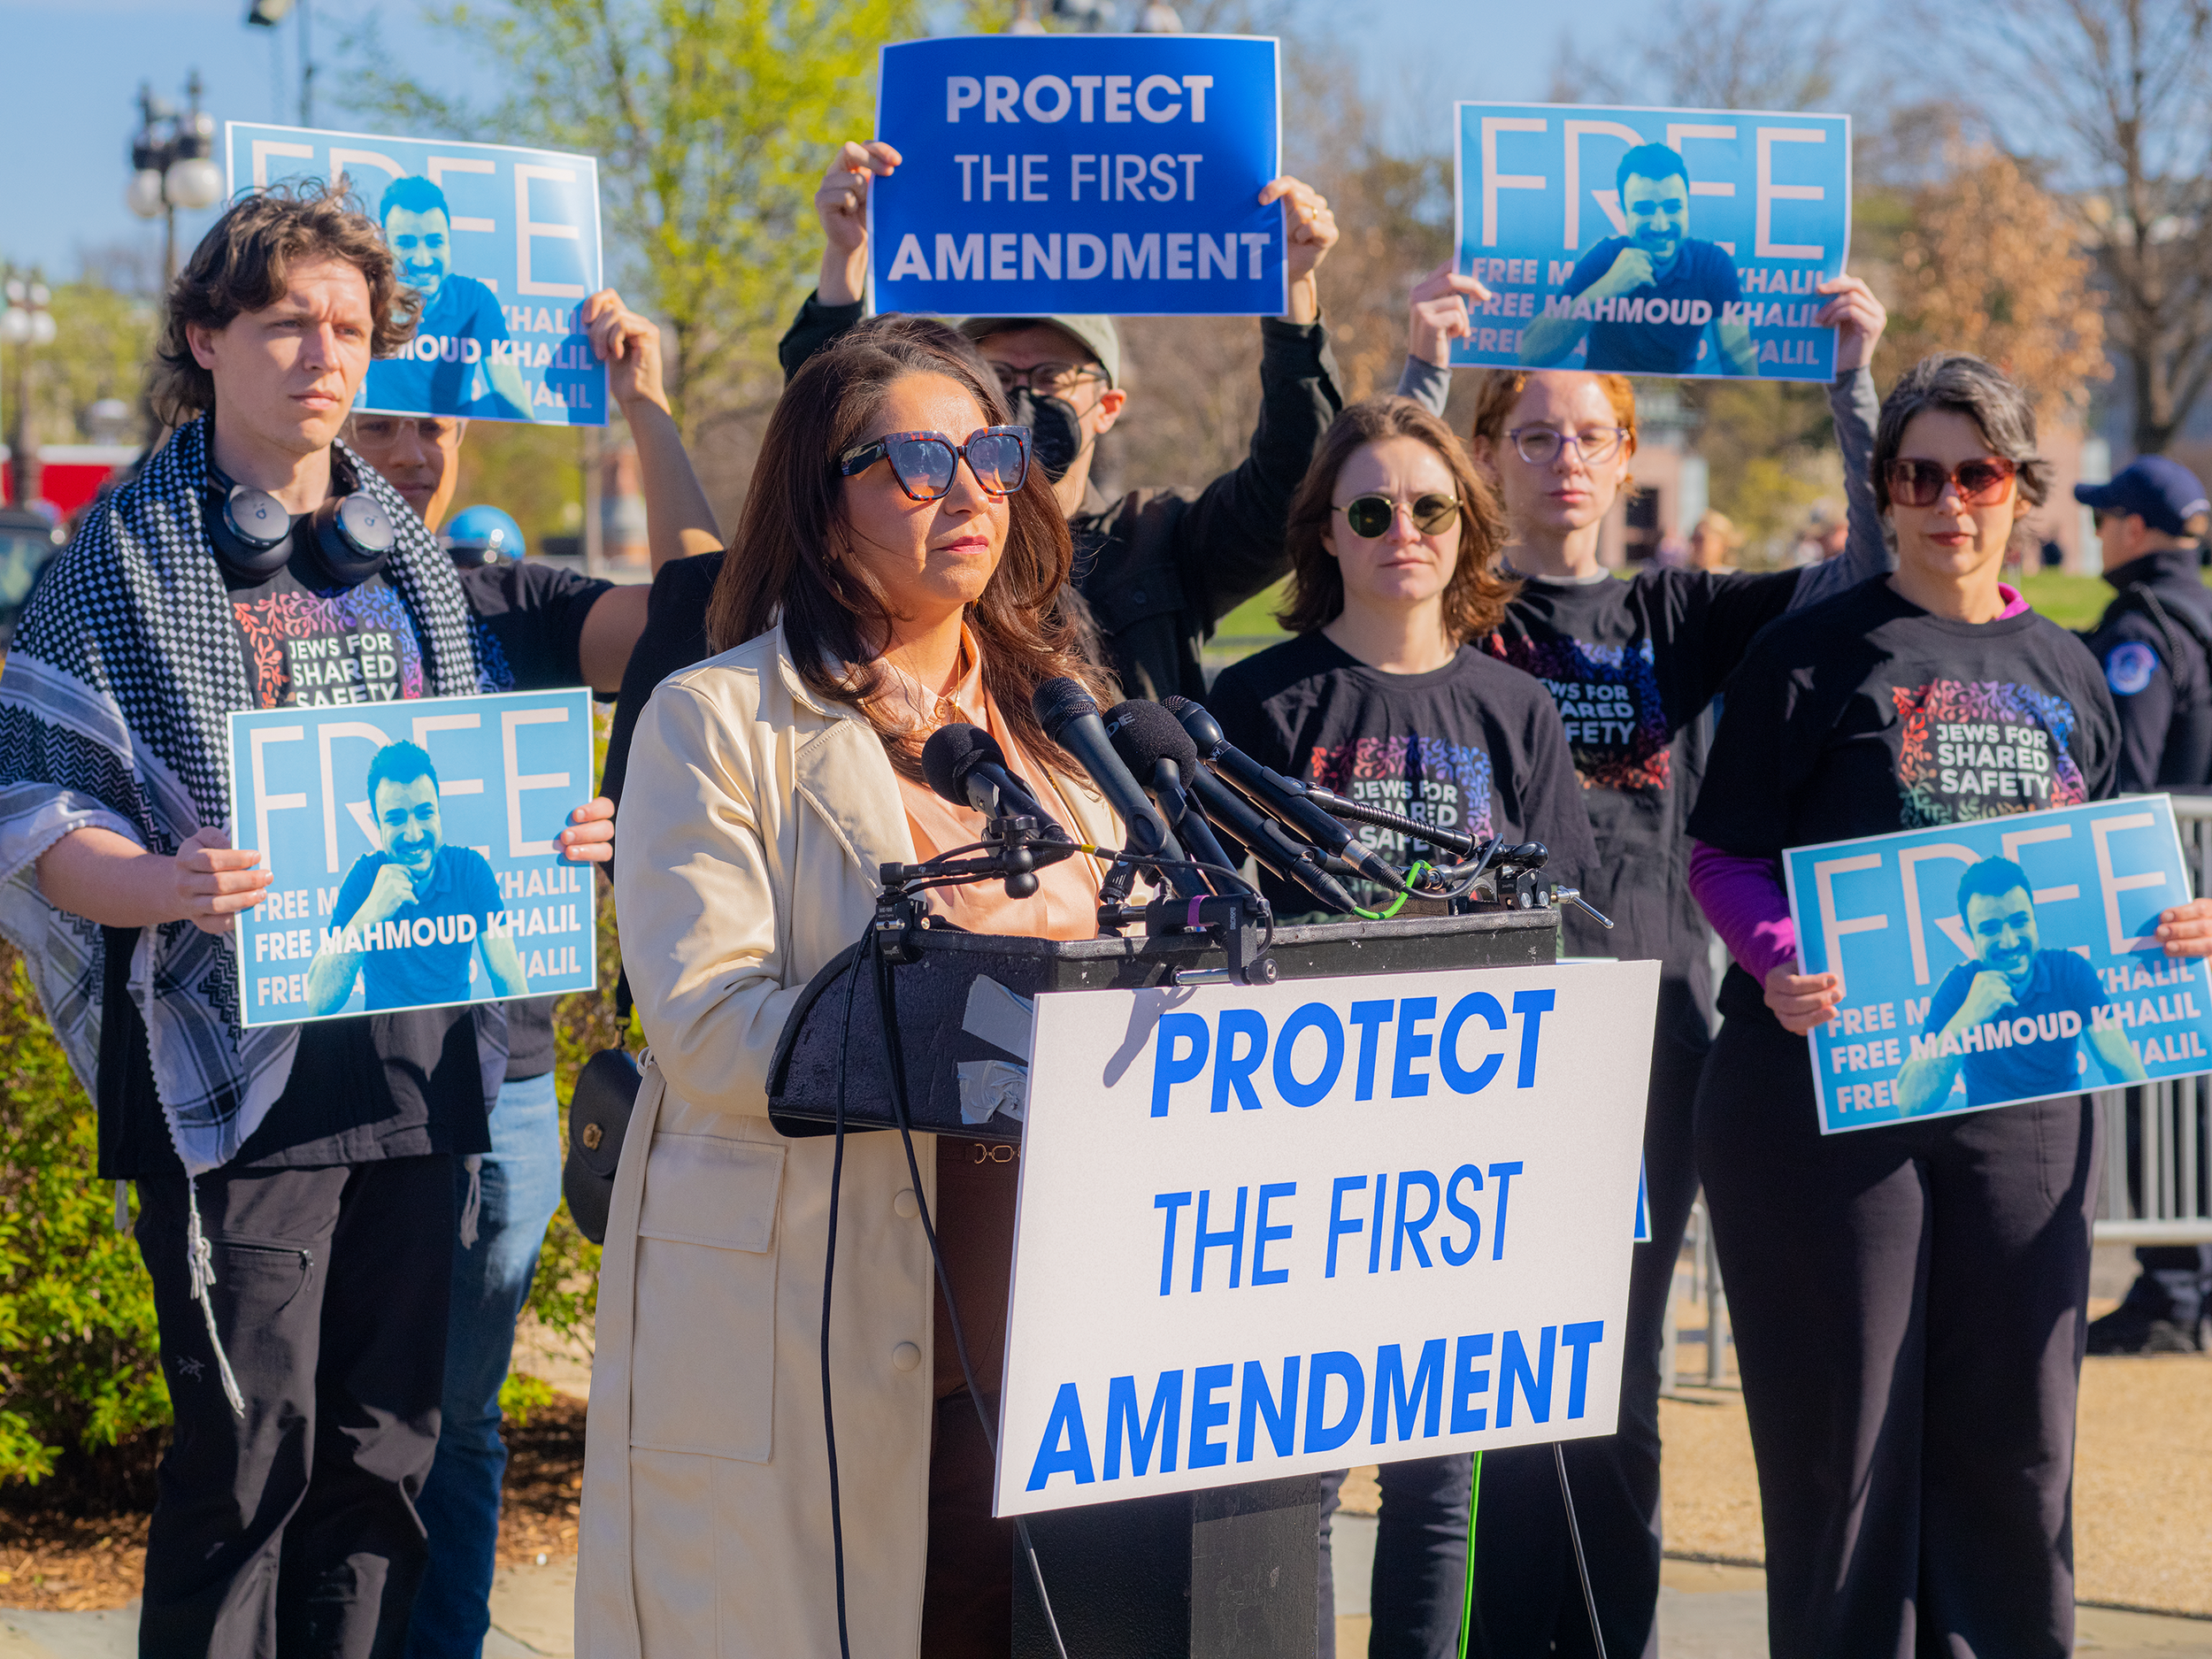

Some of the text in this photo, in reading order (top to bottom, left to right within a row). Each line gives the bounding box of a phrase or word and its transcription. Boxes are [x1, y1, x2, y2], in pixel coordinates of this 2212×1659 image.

[947, 73, 1214, 124] PROTECT
[954, 153, 1203, 202] THE FIRST
[1481, 116, 1827, 260] FREE
[887, 233, 1271, 281] AMENDMENT
[1471, 257, 1538, 284] FREE
[1467, 291, 1823, 328] FREE MAHMOUD KHALIL
[397, 334, 594, 371] MOUD KHALIL
[1751, 338, 1820, 365] ALIL
[525, 380, 593, 409] ALIL
[288, 632, 395, 660] JEWS FOR
[292, 654, 398, 687] SHARED
[1540, 678, 1630, 701] WS FOR
[1560, 700, 1635, 718] ARED
[1564, 720, 1636, 744] FETY
[1936, 724, 2048, 750] JEWS FOR
[1938, 742, 2050, 772] SHARED
[250, 706, 571, 873] FREE
[1353, 780, 1459, 804] JEWS FOR
[1940, 768, 2051, 799] SAFETY
[1360, 800, 1459, 827] ARED
[1358, 826, 1448, 855] SAF
[254, 889, 310, 922] FREE
[1814, 812, 2168, 998] FREE
[255, 903, 581, 963] FREE MAHMOUD KHALIL
[518, 946, 581, 979] ALIL
[1826, 1002, 1896, 1038] FREE
[1831, 1038, 1901, 1074] FREE
[1909, 1010, 2083, 1062] MAHMOUD
[2090, 991, 2202, 1033] KHALIL
[1150, 988, 1556, 1118] PROTECT
[2131, 1031, 2208, 1065] ALIL
[1154, 1161, 1524, 1297] THE FIRST
[1025, 1320, 1604, 1492] AMENDMENT
